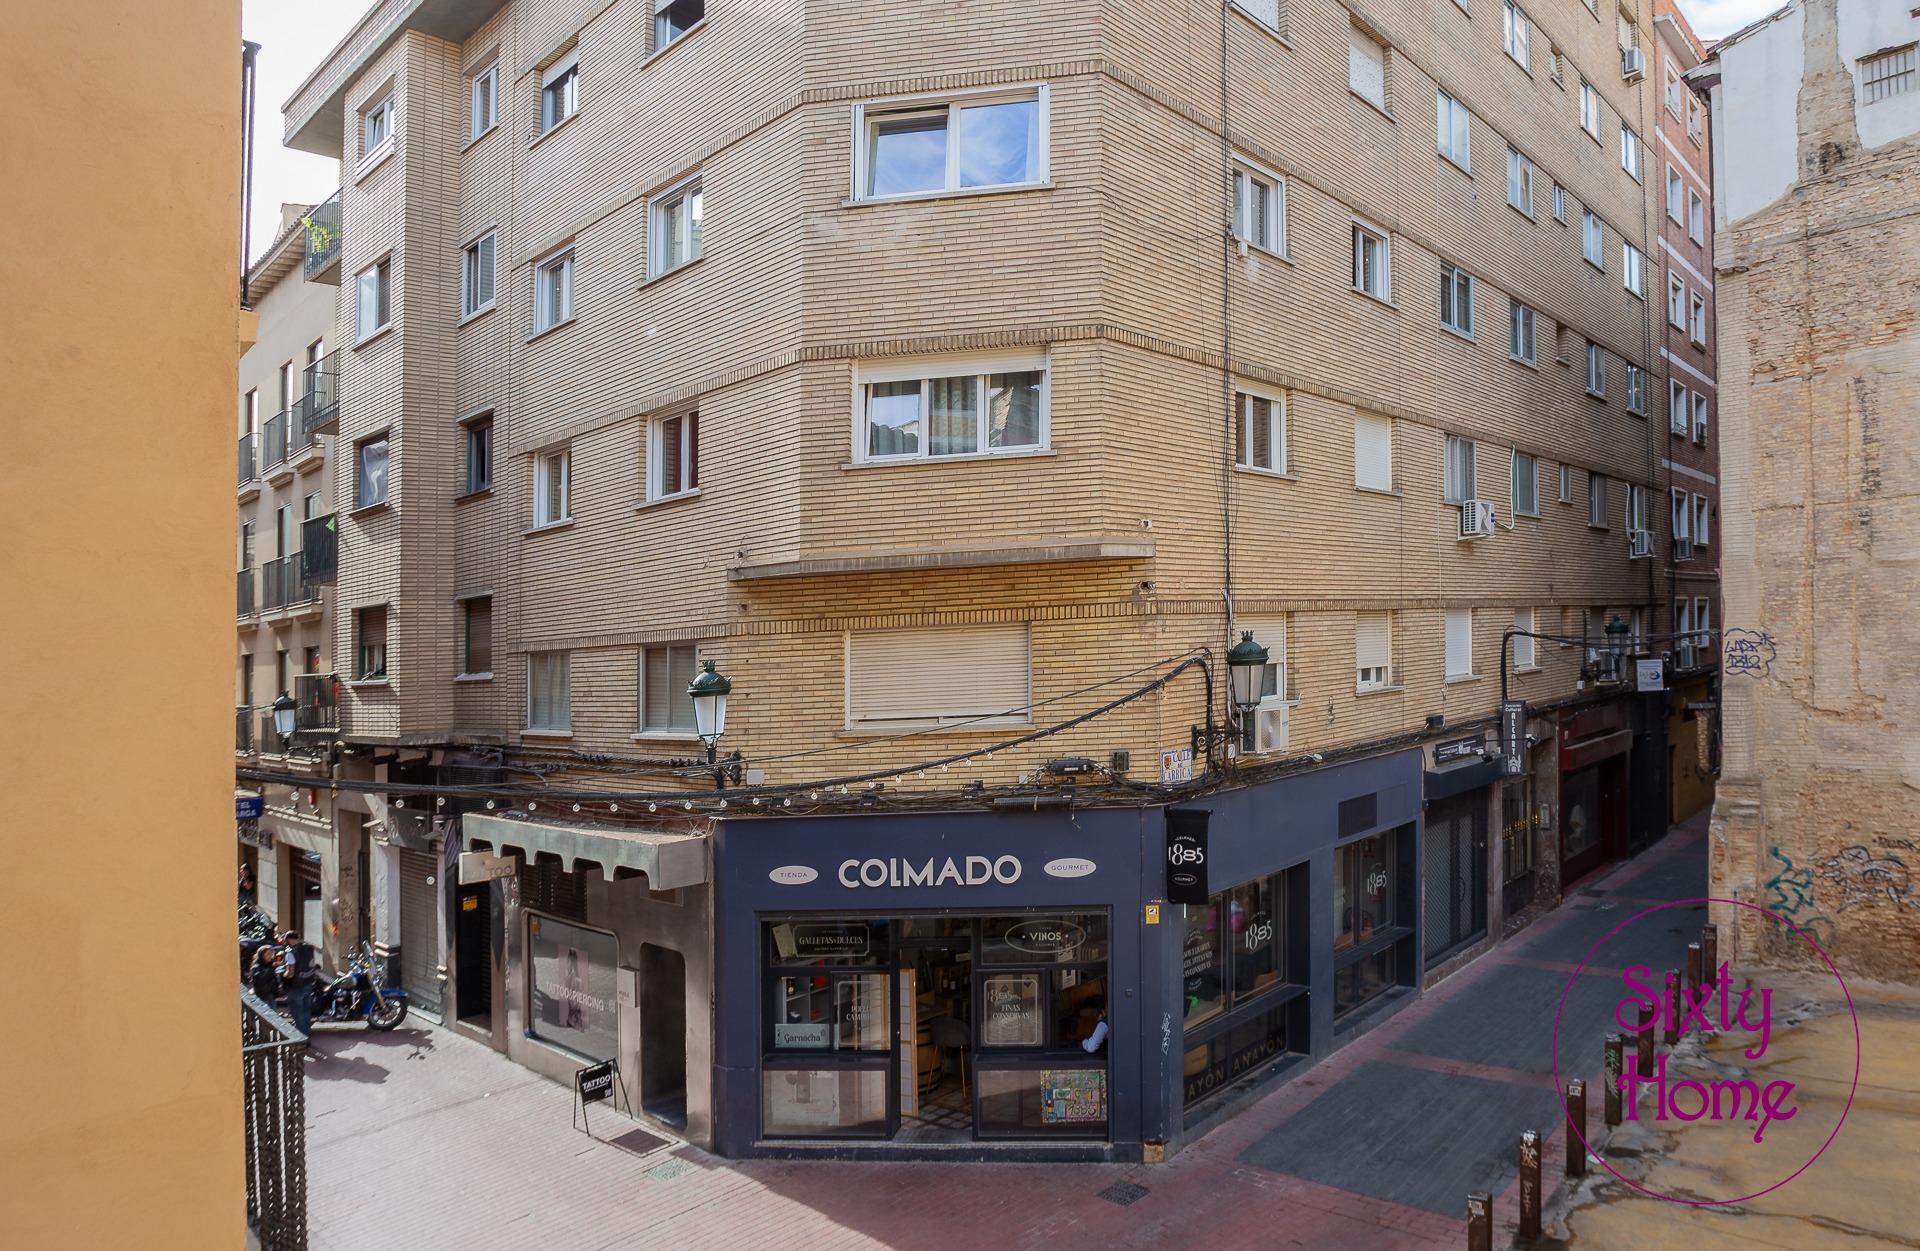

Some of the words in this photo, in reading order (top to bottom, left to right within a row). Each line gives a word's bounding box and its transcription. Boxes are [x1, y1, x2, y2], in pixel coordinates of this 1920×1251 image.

[1168, 843, 1204, 865] 1885
[838, 854, 1022, 888] COLMADO
[1367, 870, 1387, 896] 1885
[1029, 932, 1062, 941] VINOS
[1246, 920, 1272, 950] 1885
[784, 1032, 821, 1043] Garnacha
[582, 1074, 611, 1090] TATTOO
